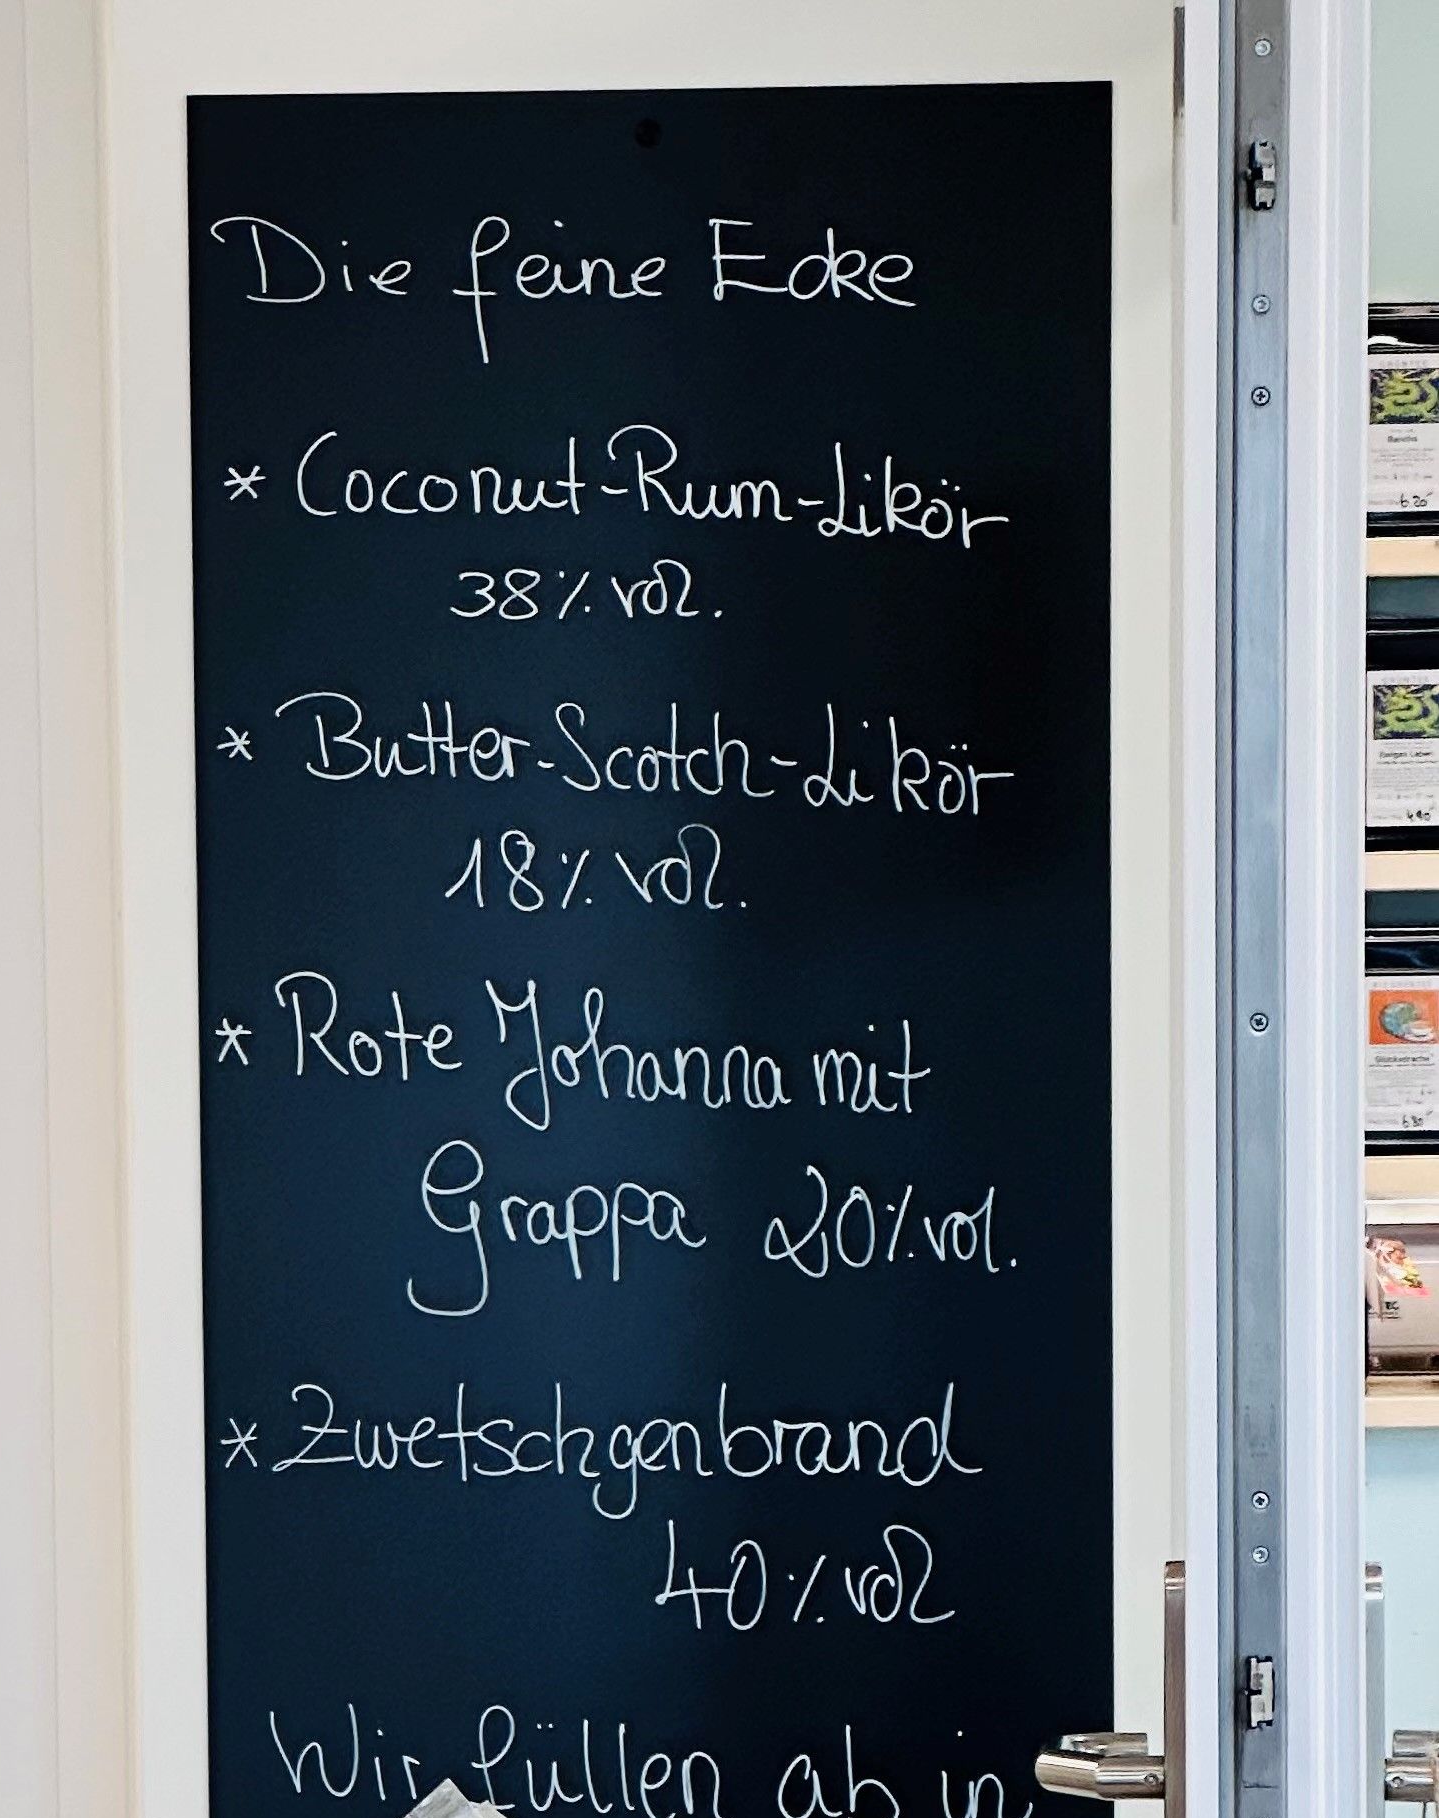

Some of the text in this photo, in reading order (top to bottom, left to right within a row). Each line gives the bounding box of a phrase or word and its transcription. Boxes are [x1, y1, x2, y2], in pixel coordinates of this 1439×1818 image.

[210, 217, 411, 303] Die
[453, 216, 665, 363] feine
[297, 425, 1009, 548] Coconut-Rum-Likör
[275, 692, 1014, 815] Butter-Scotch-Likör
[275, 971, 930, 1131] Rote Johanna mit
[407, 1140, 706, 1316] Grappa
[272, 1382, 982, 1523] Zwetschgenbrand
[269, 1702, 421, 1801] Wir
